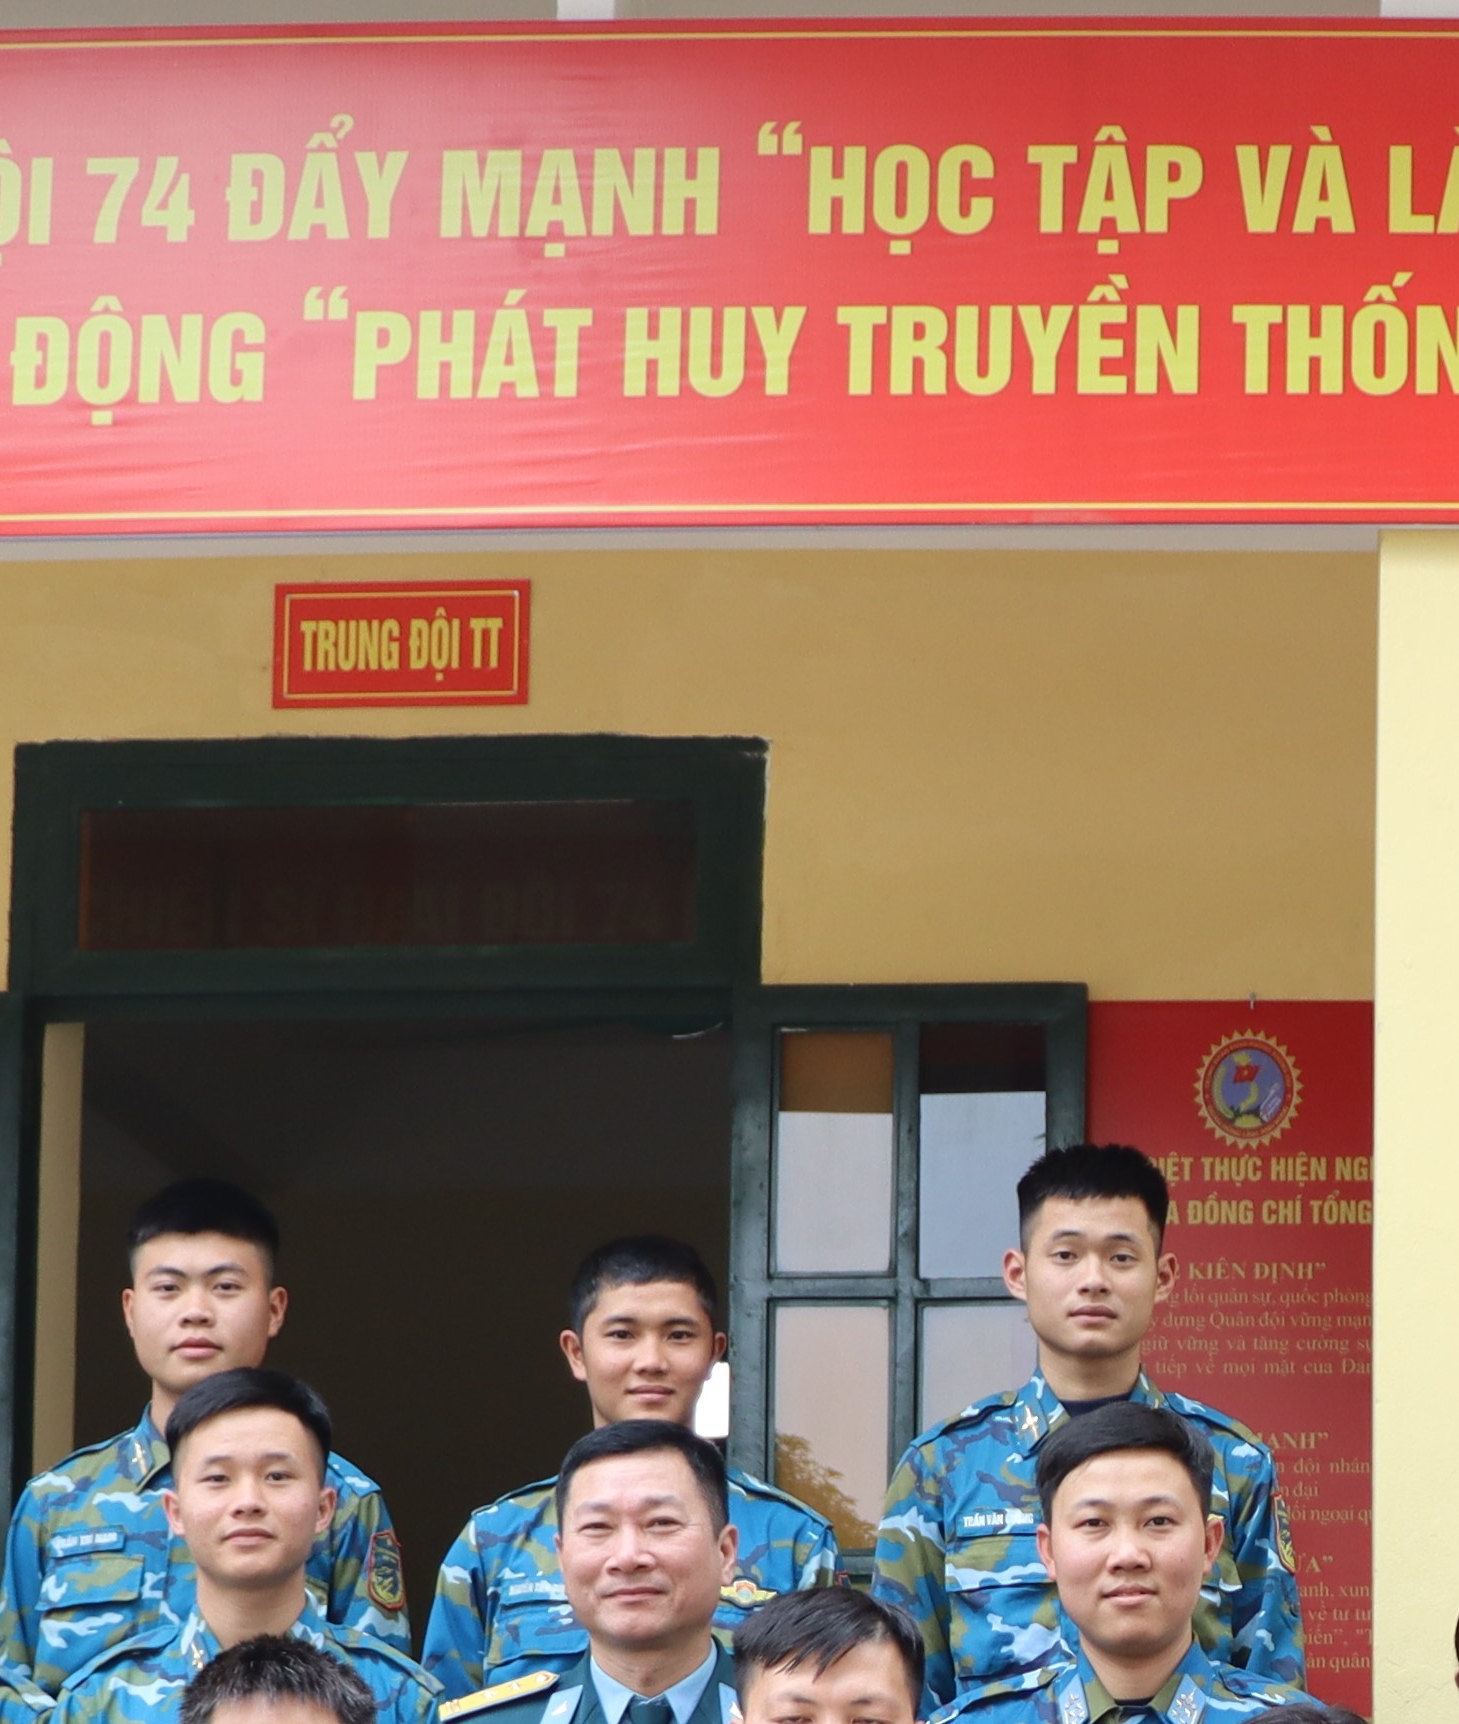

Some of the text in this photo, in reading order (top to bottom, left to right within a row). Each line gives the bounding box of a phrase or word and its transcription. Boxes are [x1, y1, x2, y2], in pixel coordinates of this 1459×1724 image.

[85, 155, 196, 243] 74
[224, 113, 409, 241] ĐẨY
[439, 146, 721, 257] MẠNH
[756, 120, 995, 255] “HỌC
[1026, 124, 1204, 254] TẬP
[1235, 124, 1356, 233] VÀ
[9, 294, 266, 425] ĐỘNG
[303, 285, 593, 400] “PHÁT
[623, 305, 807, 397] HUY
[836, 273, 1201, 396] TRUYỀN
[299, 607, 505, 681] TRUNG ĐỘI TT
[1201, 1152, 1327, 1187] THỰC HIỆN
[1188, 1190, 1371, 1225] ĐỒNG CHÍ TỔNG
[1190, 1257, 1246, 1280] KIÊN
[1208, 1285, 1319, 1307] quân quốc
[1210, 1312, 1255, 1330] Quân
[1259, 1312, 1285, 1329] đội
[1224, 1359, 1255, 1379] mọi
[1294, 1457, 1370, 1476] đội nhân
[1311, 1504, 1353, 1524] ngoại
[1330, 1651, 1370, 1673] quân
